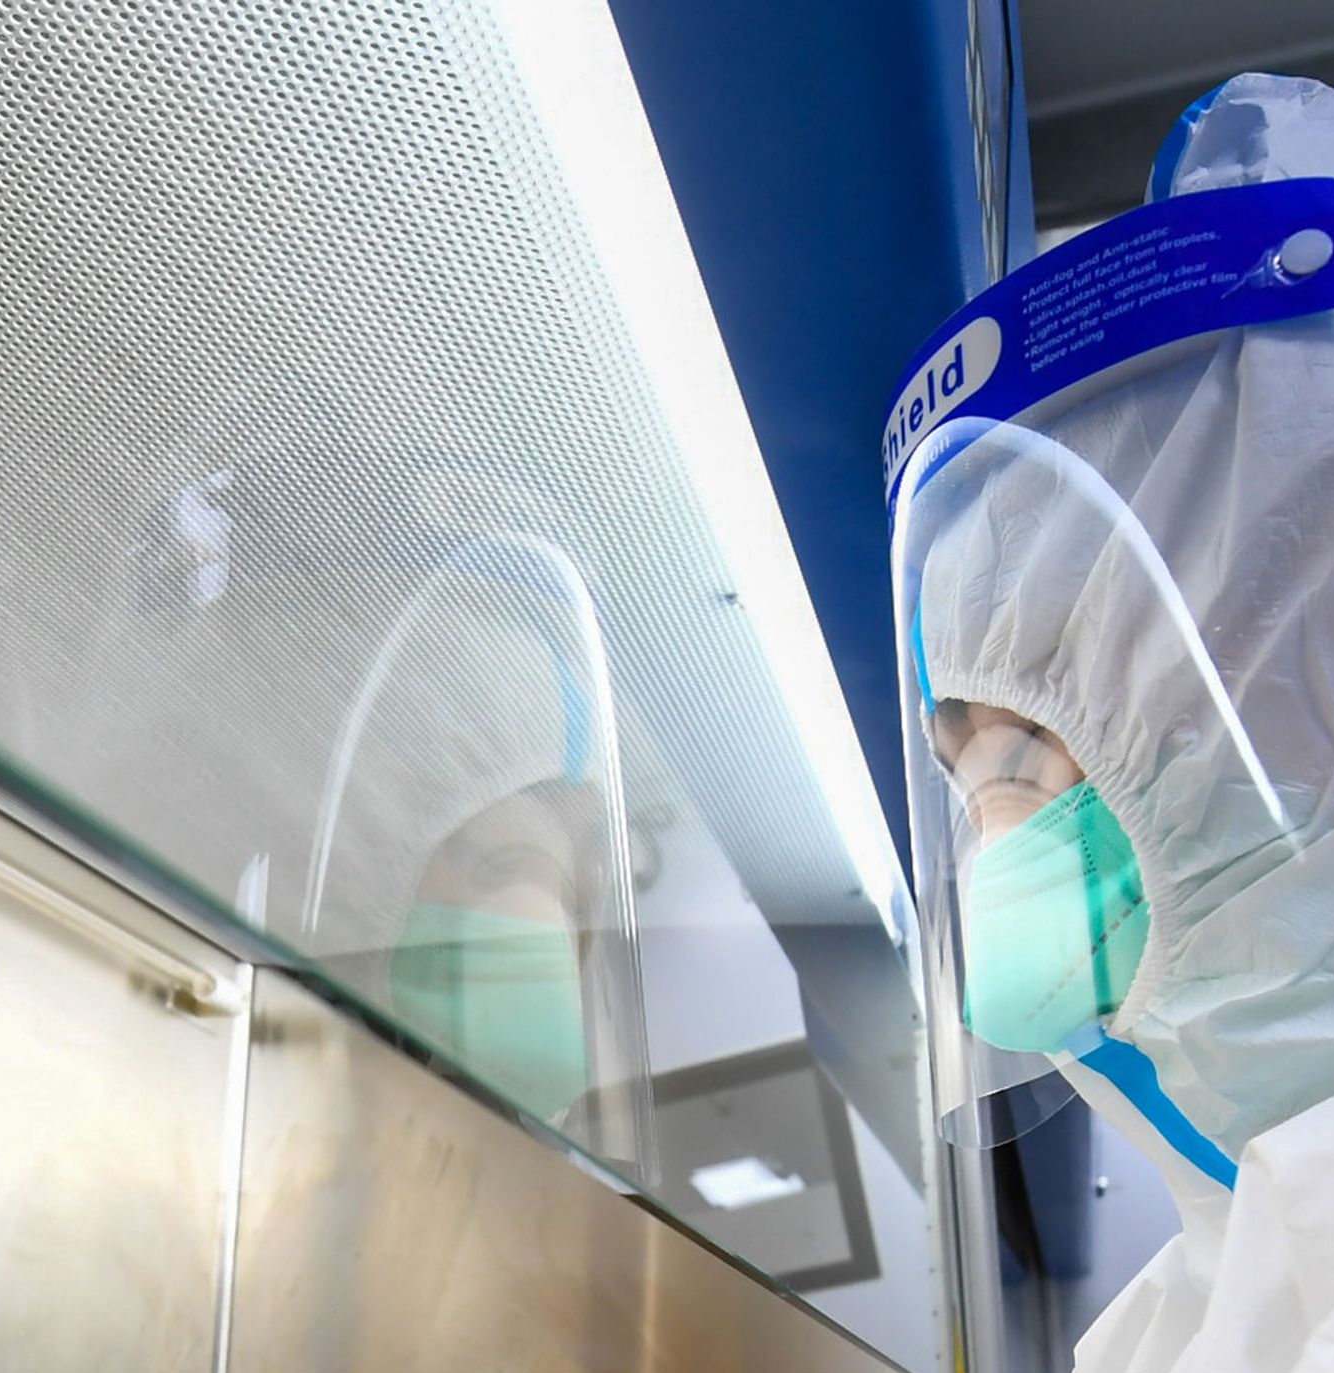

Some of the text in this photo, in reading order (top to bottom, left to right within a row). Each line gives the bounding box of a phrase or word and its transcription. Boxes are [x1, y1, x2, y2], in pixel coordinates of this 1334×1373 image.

[1028, 284, 1069, 313] Protect
[1072, 272, 1092, 289] full
[1095, 260, 1121, 278] face
[1125, 246, 1155, 265] from
[1076, 253, 1099, 272] and
[1030, 320, 1058, 343] Light
[1113, 272, 1170, 300] optically
[1173, 262, 1207, 278] clear
[1030, 327, 1077, 358] Remove
[1079, 317, 1099, 331] the
[1102, 300, 1135, 321] outer
[1139, 277, 1207, 308] protective
[1030, 329, 1105, 373] before using
